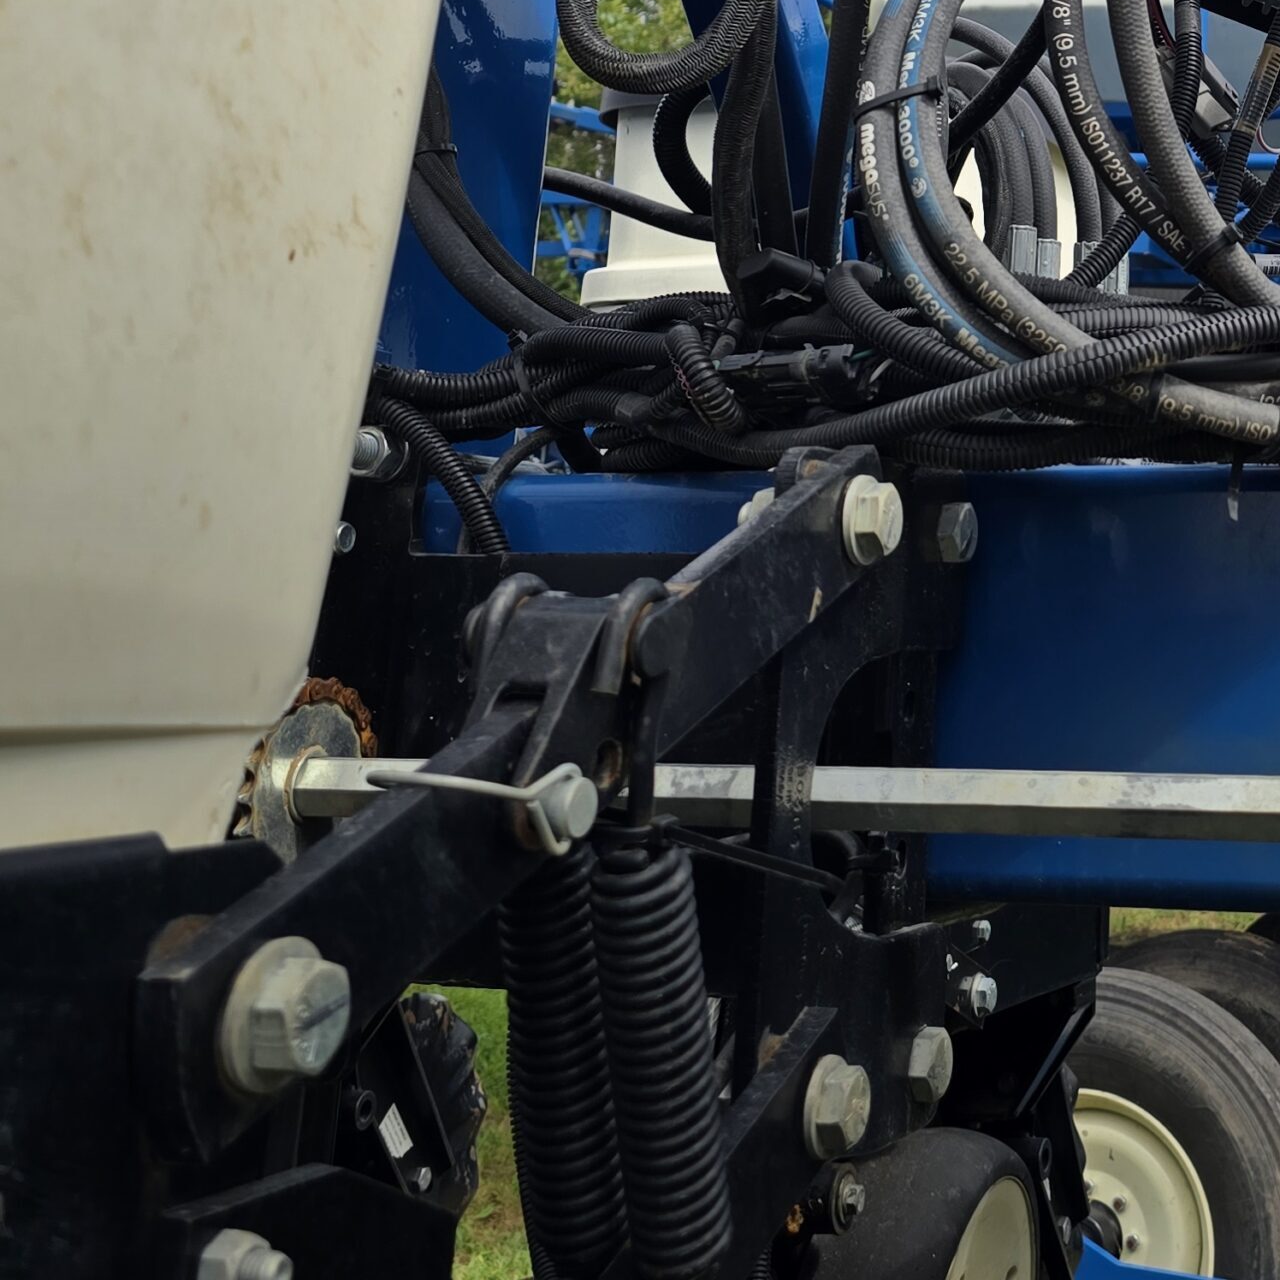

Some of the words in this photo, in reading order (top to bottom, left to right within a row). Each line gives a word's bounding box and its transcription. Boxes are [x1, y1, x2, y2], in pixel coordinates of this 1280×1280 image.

[1053, 32, 1078, 68] (9.5
[1063, 73, 1093, 116] mm)
[1124, 185, 1157, 215] R17
[903, 273, 954, 328] 6M3K
[944, 242, 981, 284] 22.5
[976, 280, 1015, 322] MPa
